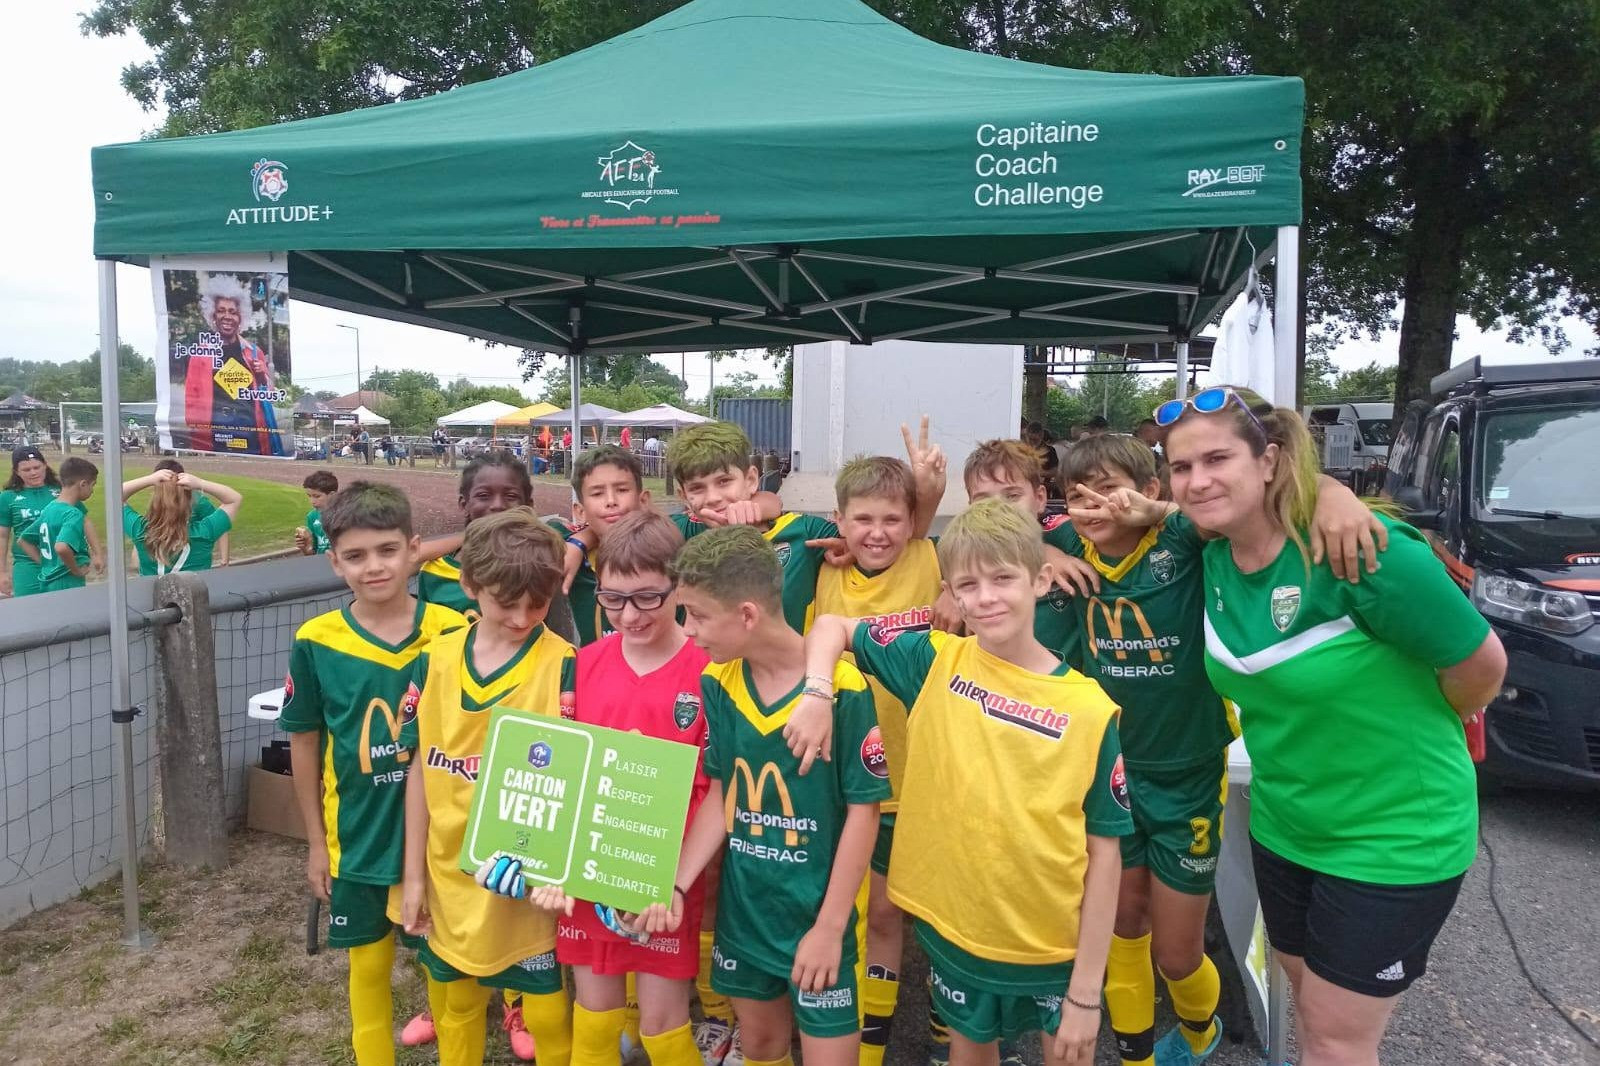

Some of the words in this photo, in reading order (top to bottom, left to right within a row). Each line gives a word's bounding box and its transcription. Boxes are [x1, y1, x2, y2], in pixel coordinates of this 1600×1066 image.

[976, 121, 1099, 150] Capitaine
[632, 172, 645, 182] 24
[975, 151, 1057, 177] Coach
[1188, 168, 1222, 185] RAY
[1227, 165, 1265, 184] BOT
[974, 182, 1103, 209] Challenge
[226, 205, 333, 225] ATTITUDE+
[176, 343, 186, 357] je
[190, 345, 222, 356] donne
[200, 333, 223, 347] Moi,
[213, 358, 222, 368] la
[238, 388, 249, 398] Et
[253, 391, 278, 400] vous
[40, 522, 53, 560] 3
[1095, 634, 1180, 651] McDonald's
[1100, 663, 1175, 678] RIBERAC
[603, 748, 658, 779] PLAISIR
[503, 767, 567, 799] CARTON
[597, 775, 653, 806] RESPECT
[498, 788, 564, 832] VERT
[592, 803, 669, 840] ENGAGEMENT
[1189, 816, 1212, 855] 3
[589, 831, 657, 867] TOLERANCE
[729, 837, 809, 863] RIBERAC
[816, 997, 853, 1008] PEYROU
